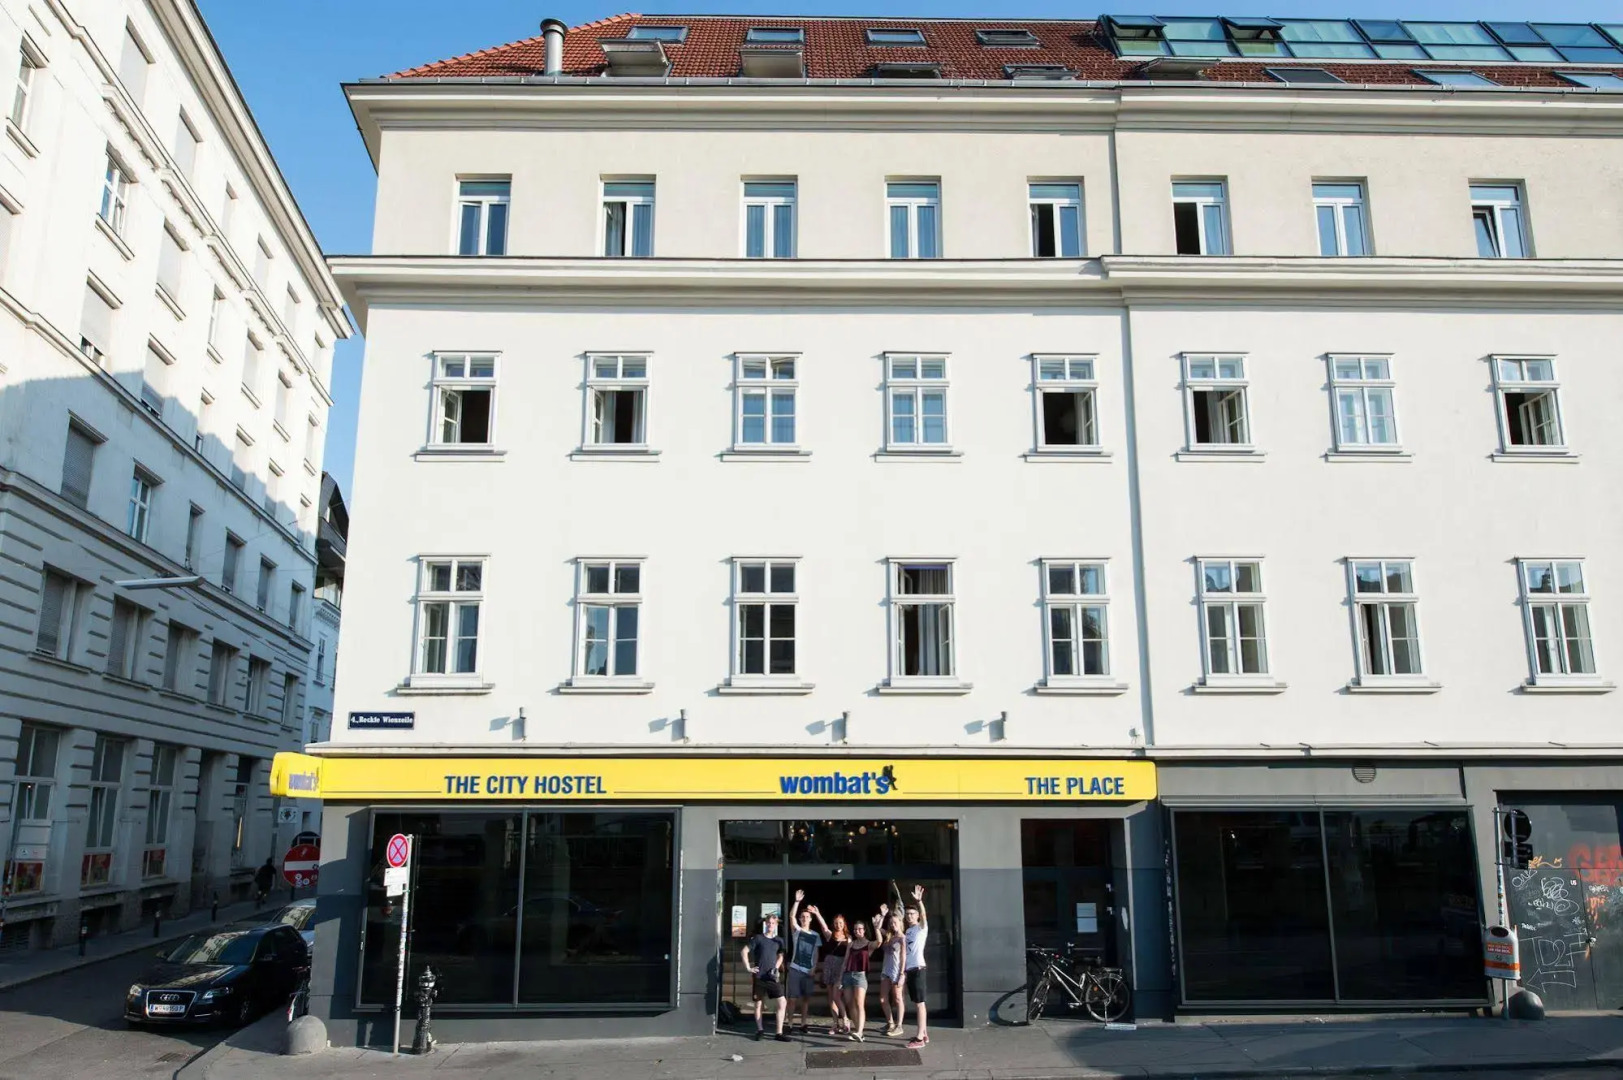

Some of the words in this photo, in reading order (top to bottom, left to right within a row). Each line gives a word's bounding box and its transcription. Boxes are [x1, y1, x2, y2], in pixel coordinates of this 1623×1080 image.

[444, 775, 480, 794] THE
[486, 775, 528, 794] CITY
[534, 775, 607, 794] HOSTEL
[779, 771, 890, 795] wombat's
[1024, 777, 1061, 795] THE
[1066, 777, 1125, 795] PLACE
